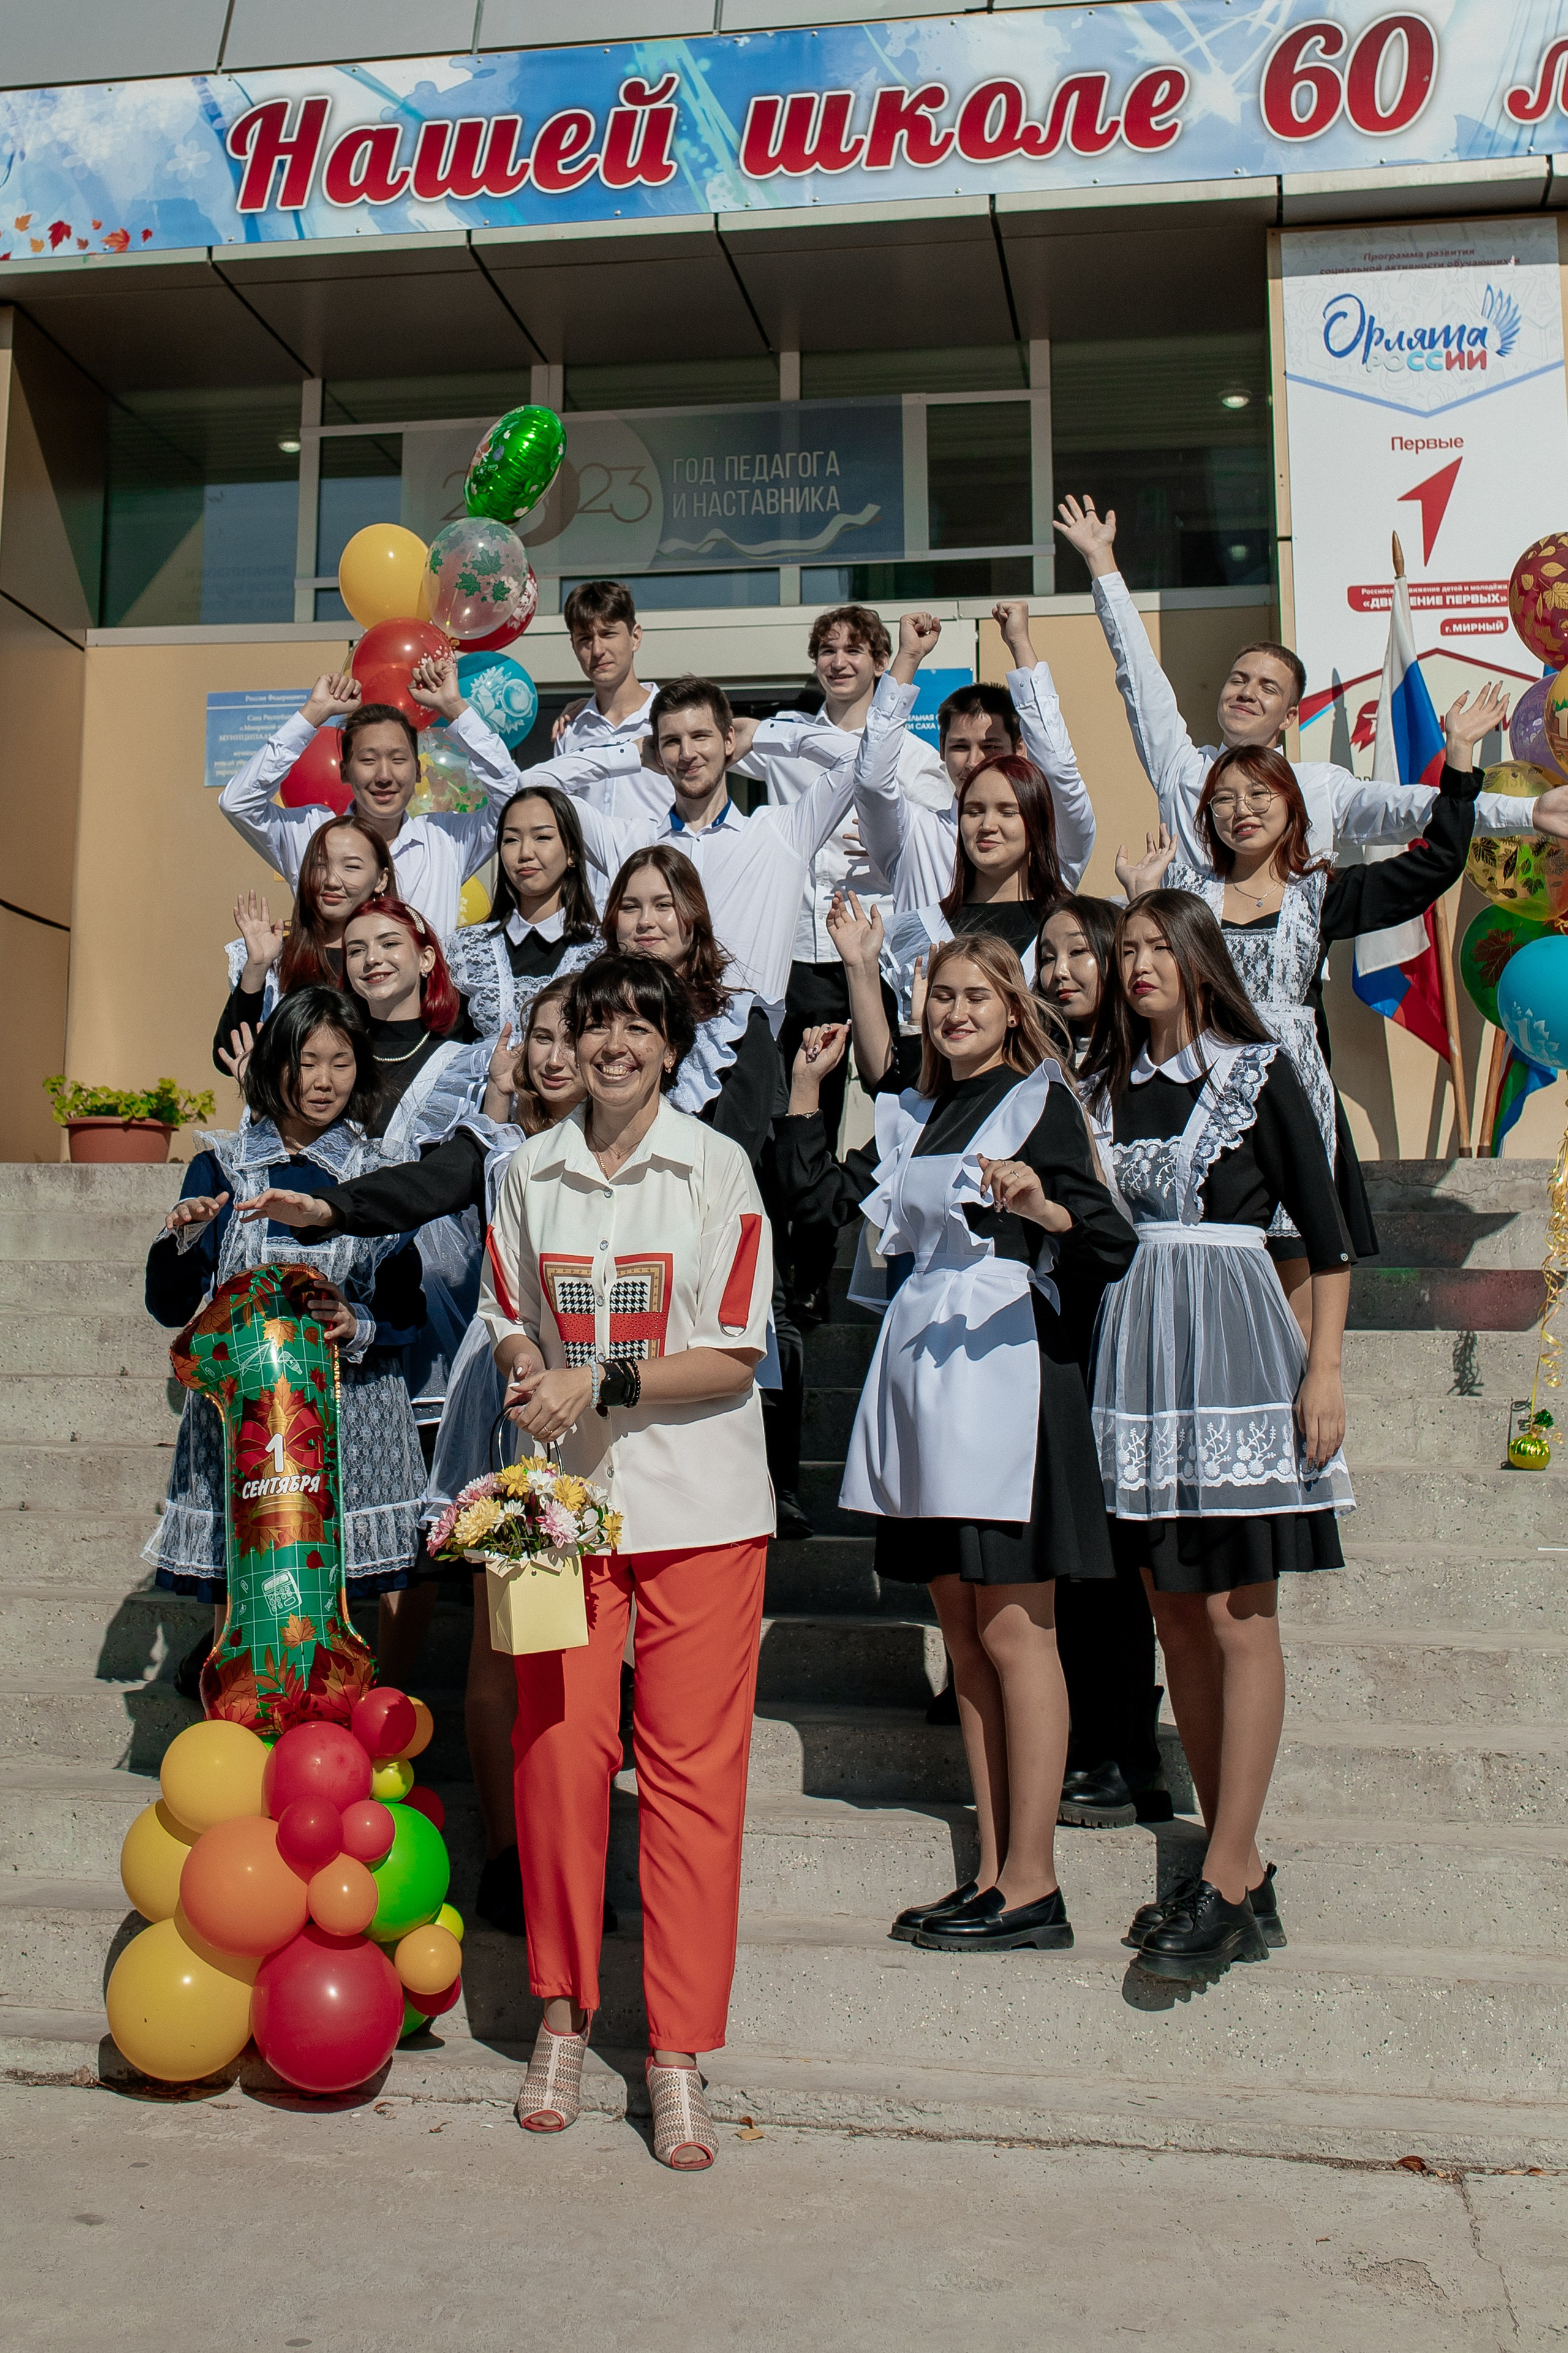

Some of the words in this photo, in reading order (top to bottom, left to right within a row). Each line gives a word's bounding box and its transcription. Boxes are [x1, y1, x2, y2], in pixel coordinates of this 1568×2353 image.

[226, 73, 679, 213] Нашей
[742, 65, 1190, 179] школе
[1259, 12, 1440, 142] 60
[1319, 264, 1382, 275] социальной
[1384, 262, 1444, 271] активности
[1363, 251, 1423, 262] Программа
[1427, 247, 1475, 258] развития
[1323, 293, 1488, 366] Орлята
[1390, 436, 1464, 454] Первые
[673, 456, 716, 486] ГОД
[725, 450, 840, 483] ПЕДАГОГА
[439, 453, 653, 547] 223
[673, 492, 687, 518] И
[693, 485, 841, 518] НАСТАВНИКА
[1442, 584, 1463, 594] детей
[1470, 583, 1508, 592] молодёжи
[1446, 593, 1508, 605] ПЕРВЫХ»
[265, 1432, 284, 1473] 1
[242, 1474, 321, 1500] СЕНТЯБРЯ
